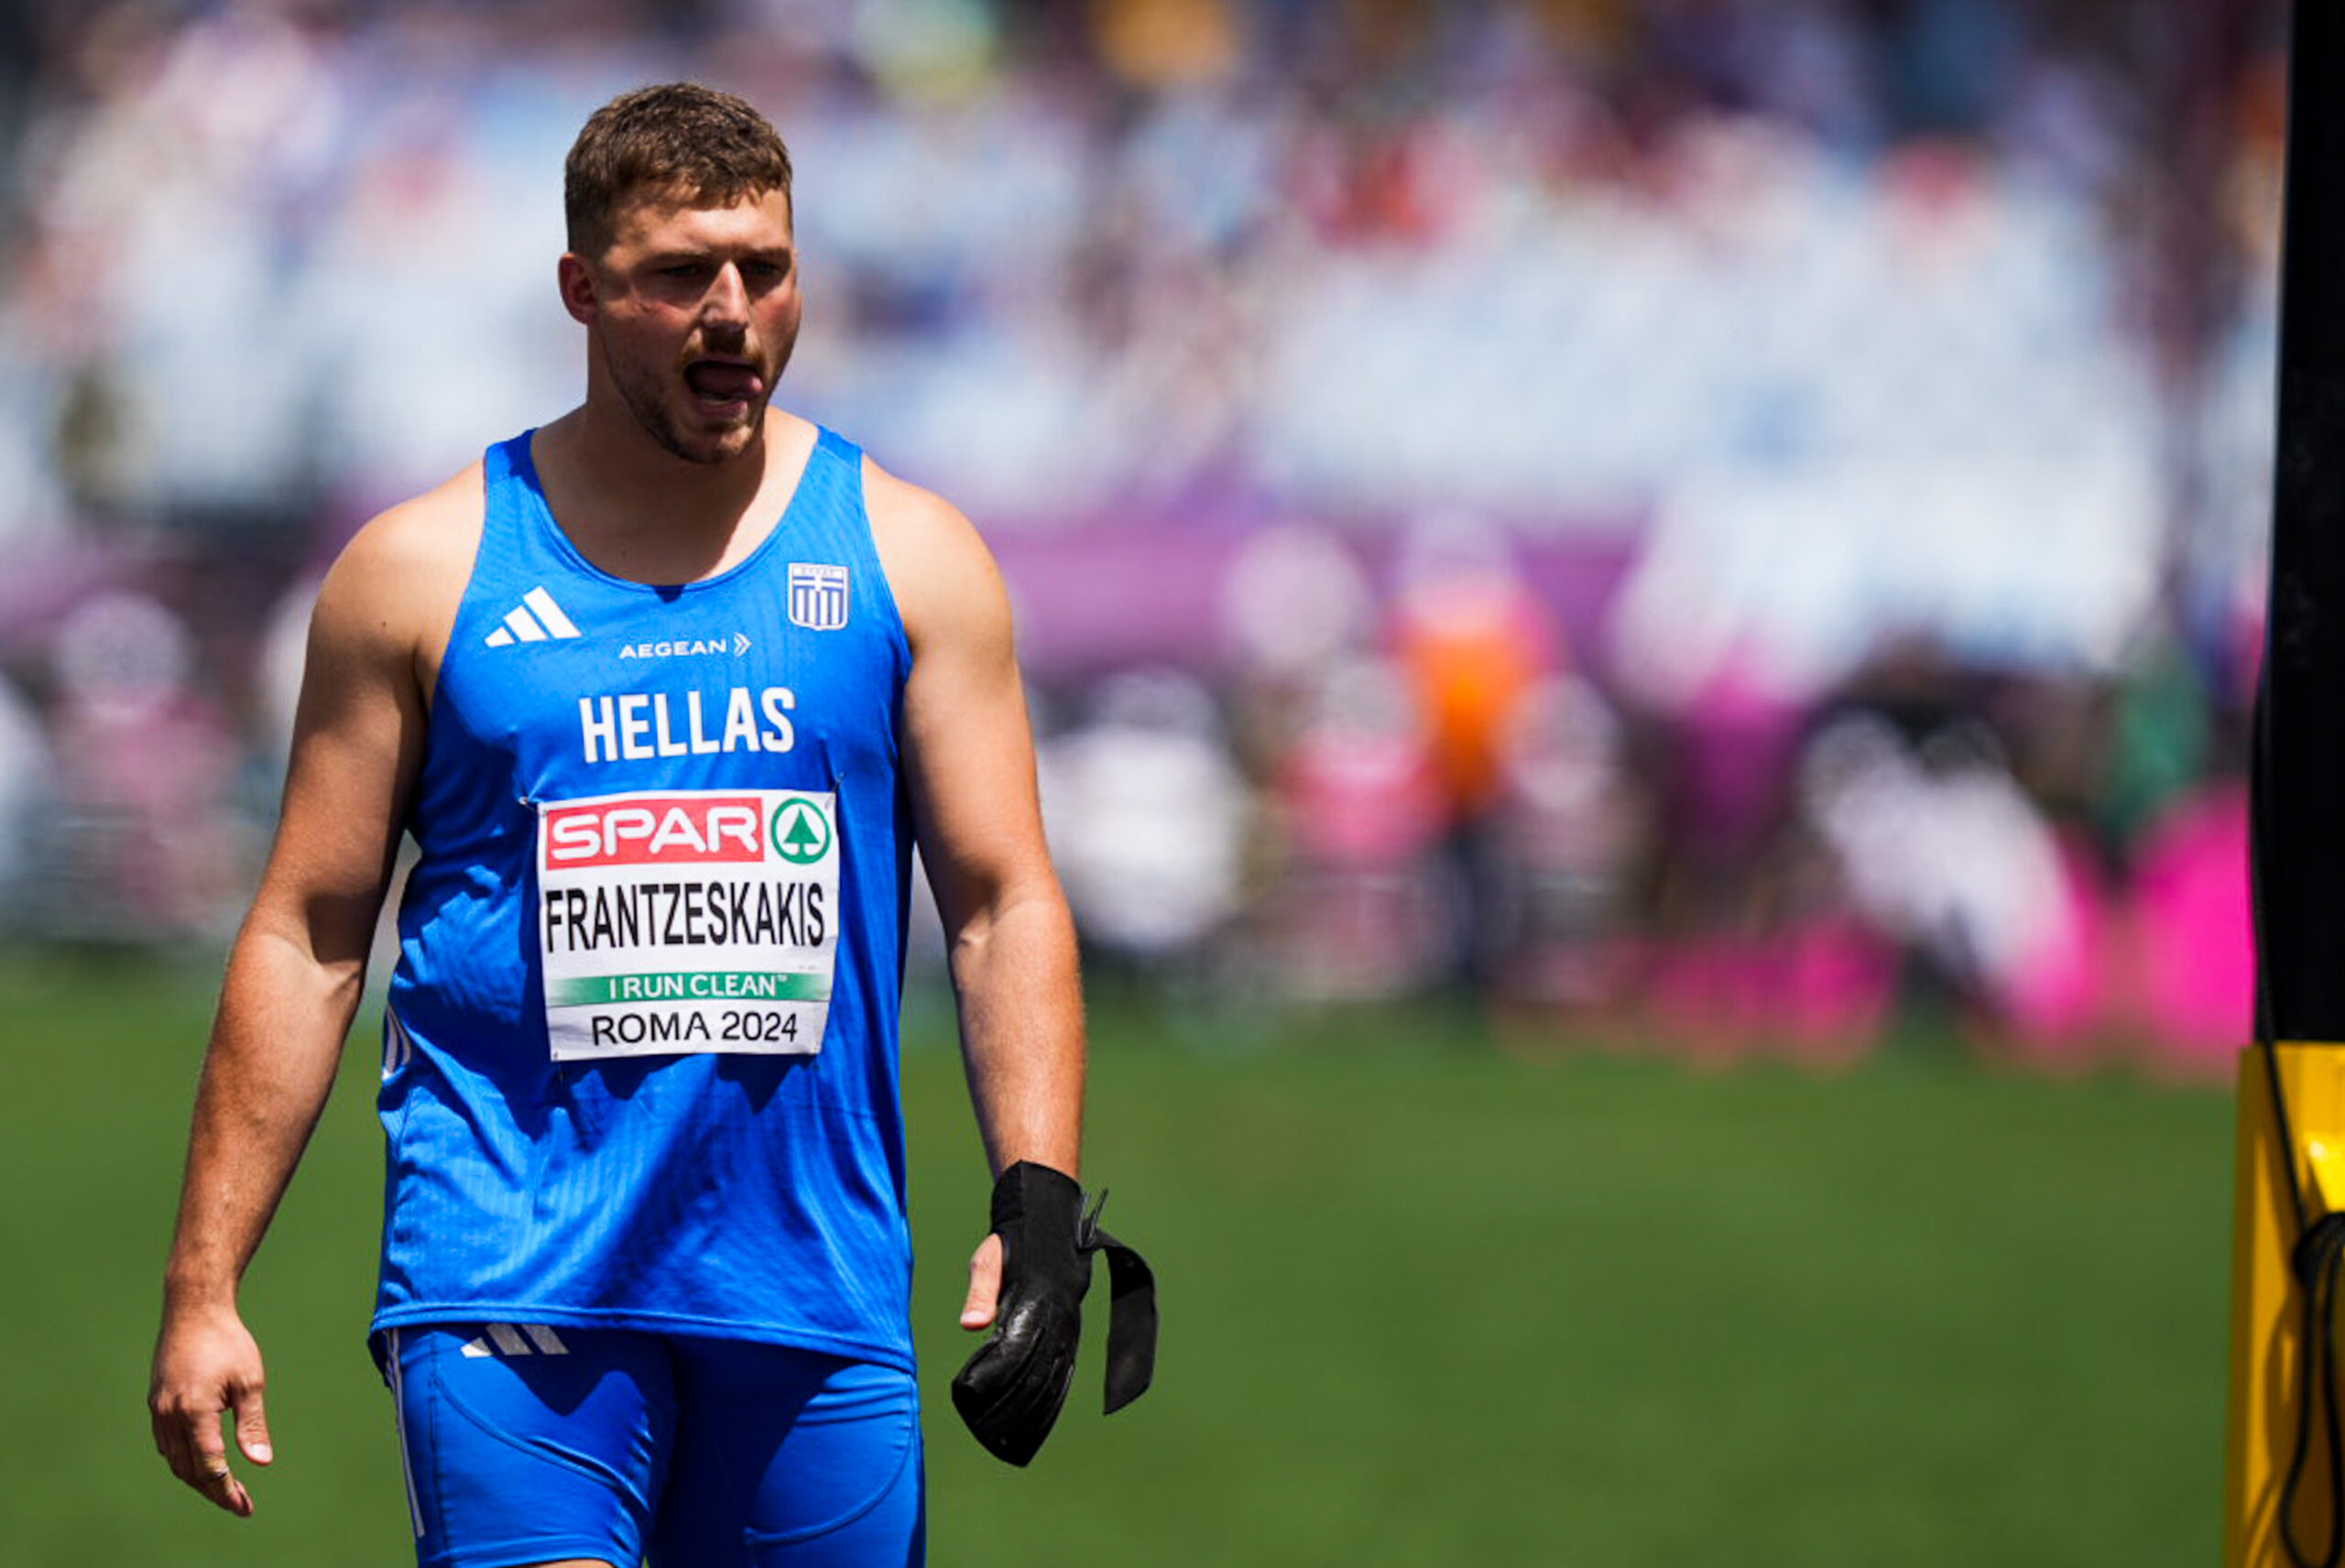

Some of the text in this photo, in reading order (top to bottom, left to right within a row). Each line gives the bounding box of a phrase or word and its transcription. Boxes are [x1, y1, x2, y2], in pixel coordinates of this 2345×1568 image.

[618, 638, 727, 659] AEGEAN
[579, 687, 797, 764] HELLAS
[551, 806, 759, 860] SPAR
[545, 881, 825, 953] FRANTZESKAKIS
[610, 978, 616, 999] I
[623, 975, 685, 998] RUN
[592, 1011, 798, 1046] ROMA 2024
